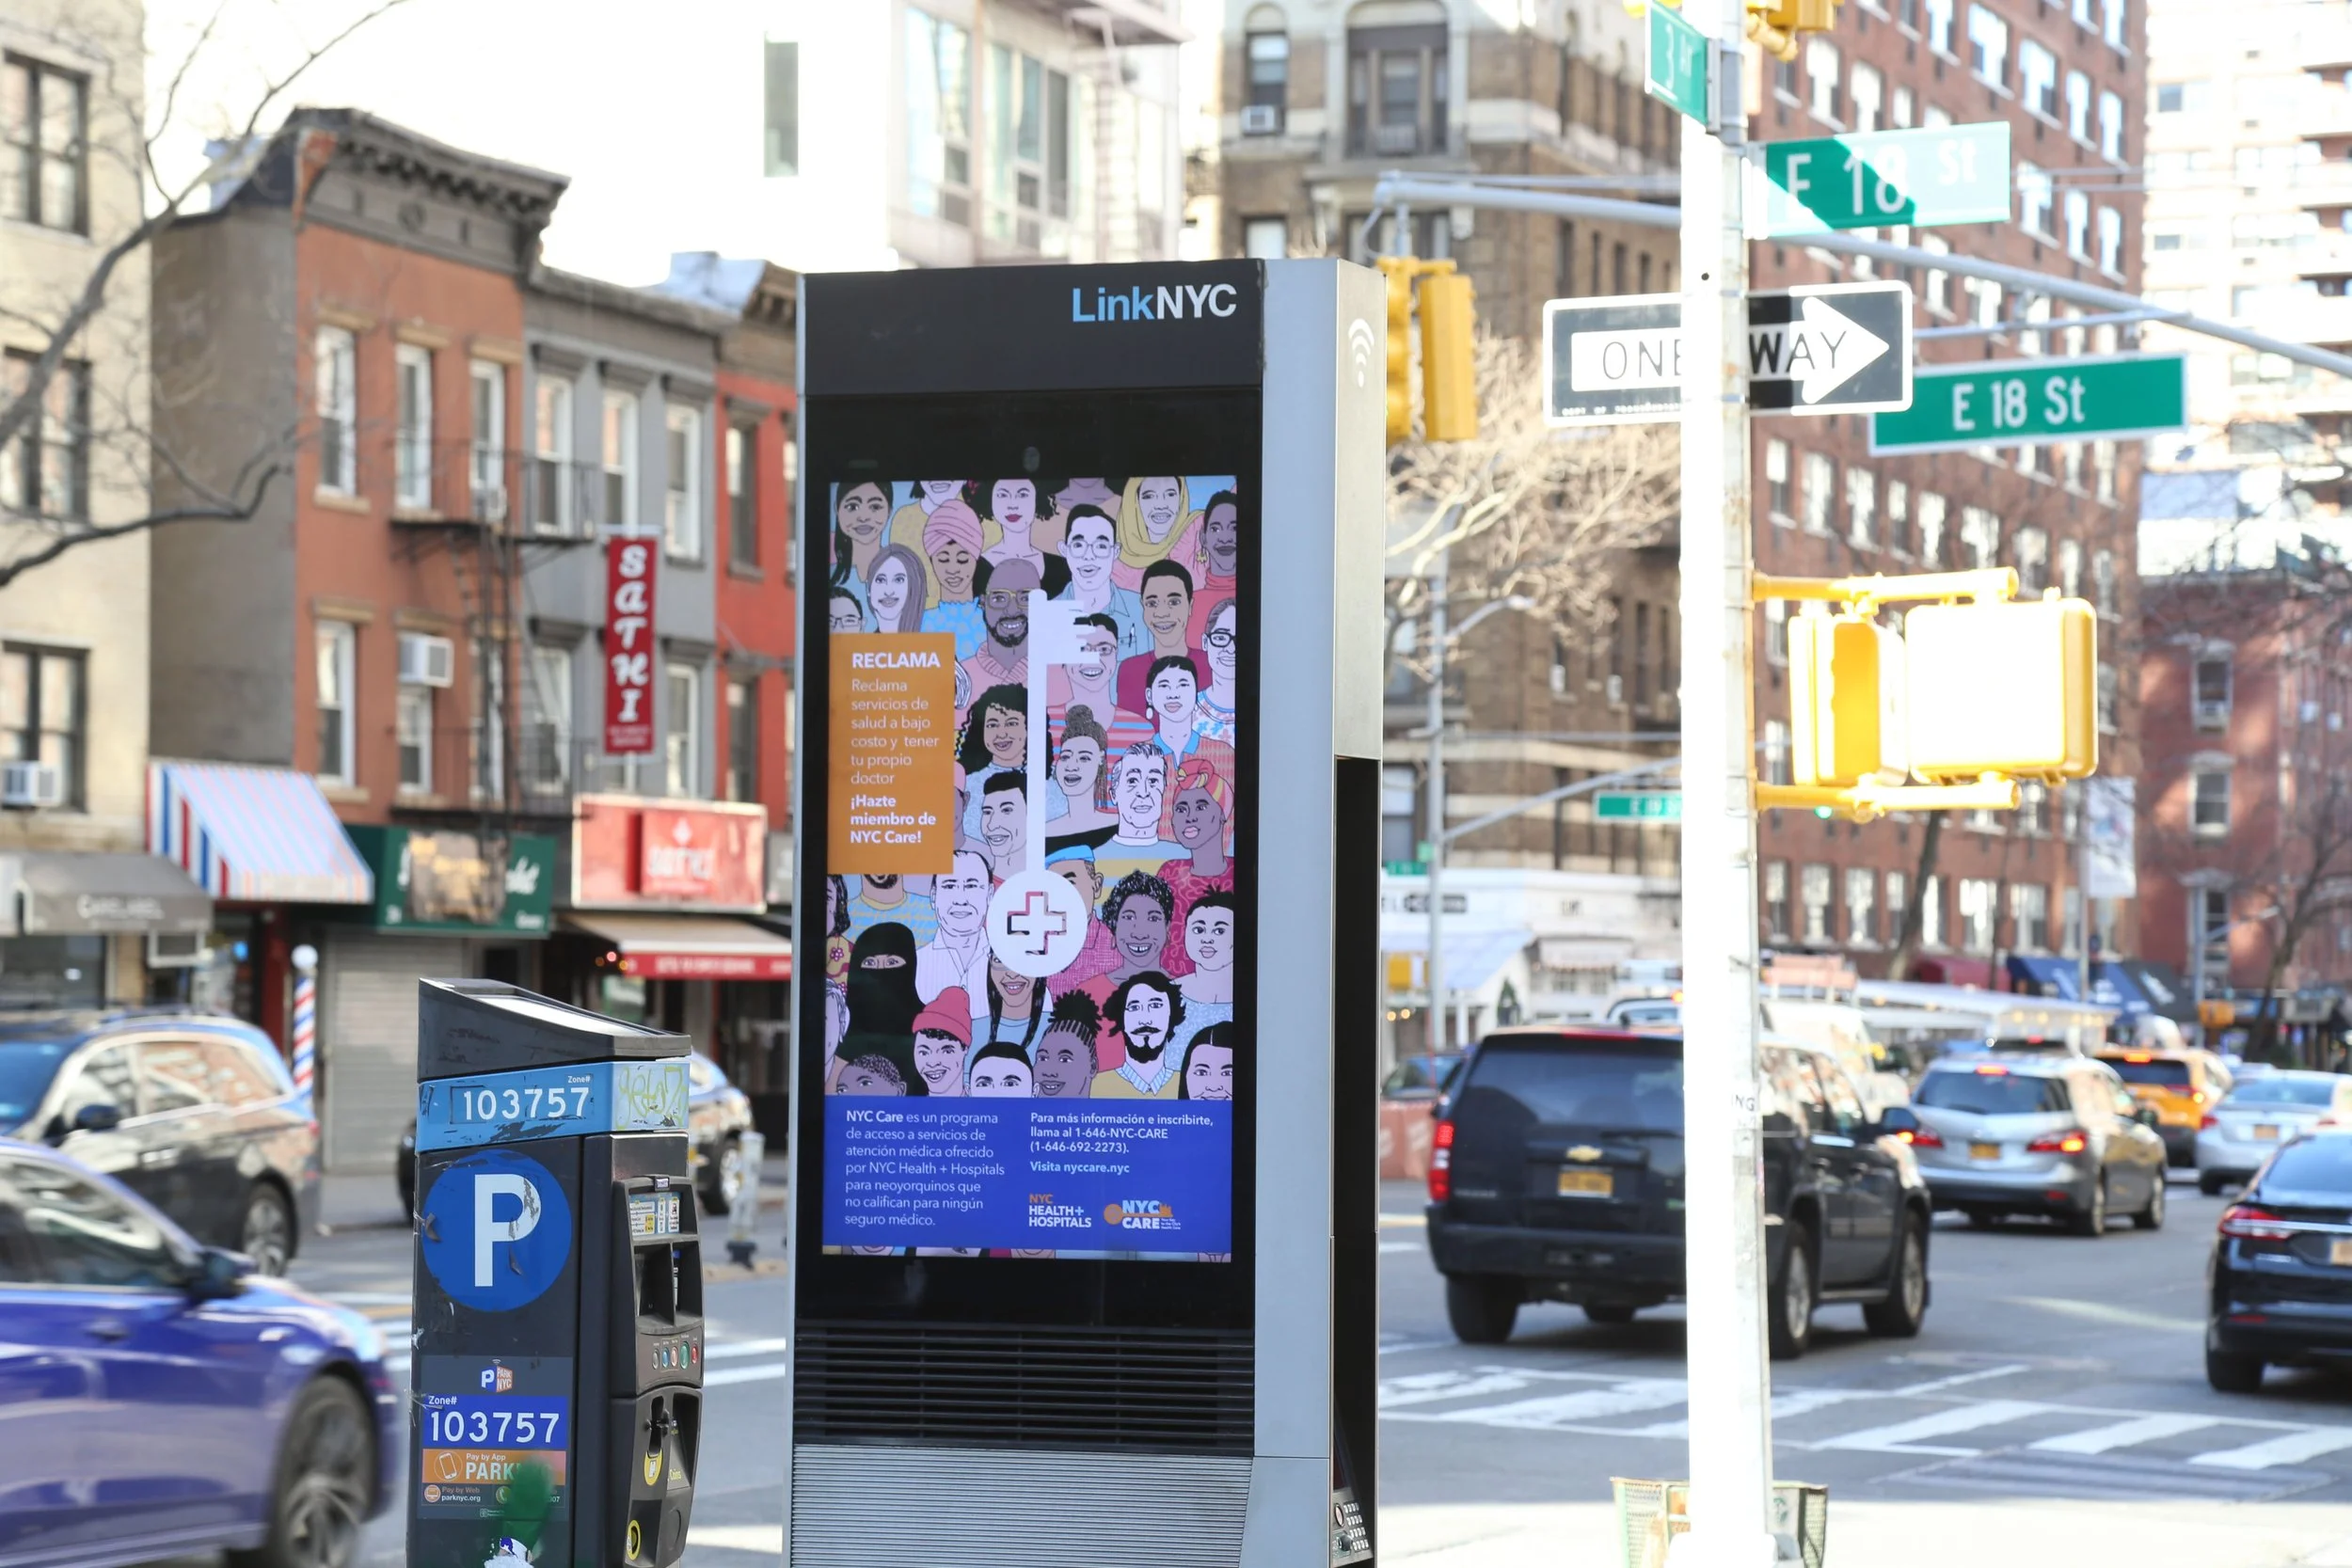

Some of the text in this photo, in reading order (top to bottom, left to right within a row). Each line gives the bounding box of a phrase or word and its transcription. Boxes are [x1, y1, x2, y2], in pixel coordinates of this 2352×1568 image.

[1843, 143, 1908, 215] 18
[1937, 138, 1977, 185] St
[1073, 283, 1237, 323] LinkNYC
[1748, 329, 1848, 374] WAY
[1952, 375, 2086, 432] E 18 St
[851, 652, 941, 669] RECLAMA
[851, 678, 908, 692] Reclama
[851, 696, 930, 710] servicios de
[850, 715, 930, 732] salud a bajo
[850, 736, 940, 752] costo y tener
[850, 752, 913, 769] tu propio
[850, 770, 895, 784] doctor
[850, 795, 897, 810] ¡Hazte
[850, 812, 936, 825] miembro de
[850, 831, 922, 844] NYC Care!
[567, 1074, 591, 1084] Zone#
[463, 1086, 590, 1121] 103757
[847, 1110, 998, 1127] NYC Care es un programa
[1030, 1113, 1054, 1123] Para
[1057, 1113, 1078, 1123] más
[1081, 1113, 1145, 1124] información
[1157, 1115, 1214, 1127] inscribirte,
[846, 1127, 986, 1141] de acceso a servicios de
[1030, 1127, 1168, 1139] llama al 1-646-NYC-CARE
[846, 1145, 993, 1158] atención médica ofrecido
[1030, 1141, 1129, 1154] (1-646-692-2273).
[846, 1164, 866, 1176] por
[869, 1162, 896, 1174] NYC
[899, 1163, 936, 1174] Health
[951, 1164, 1005, 1178] Hospitals
[1030, 1161, 1130, 1175] Visita nyccare.nyc
[846, 1180, 981, 1195] para neoyorquinos que
[846, 1196, 983, 1212] no califican para ningún
[1029, 1194, 1054, 1204] NYC
[1122, 1200, 1160, 1214] NYC
[845, 1213, 935, 1227] seguro médico.
[1029, 1217, 1091, 1227] HOSPITALS
[1122, 1217, 1160, 1229] CARE
[475, 1174, 542, 1287] P
[481, 1369, 495, 1388] P
[497, 1366, 513, 1380] PARK
[497, 1378, 513, 1391] NYC
[428, 1395, 457, 1405] Zone#
[431, 1410, 560, 1444] 103757
[466, 1452, 480, 1461] Pay
[491, 1453, 506, 1462] App
[442, 1486, 454, 1495] Pay
[441, 1494, 482, 1503] parknyc.org
